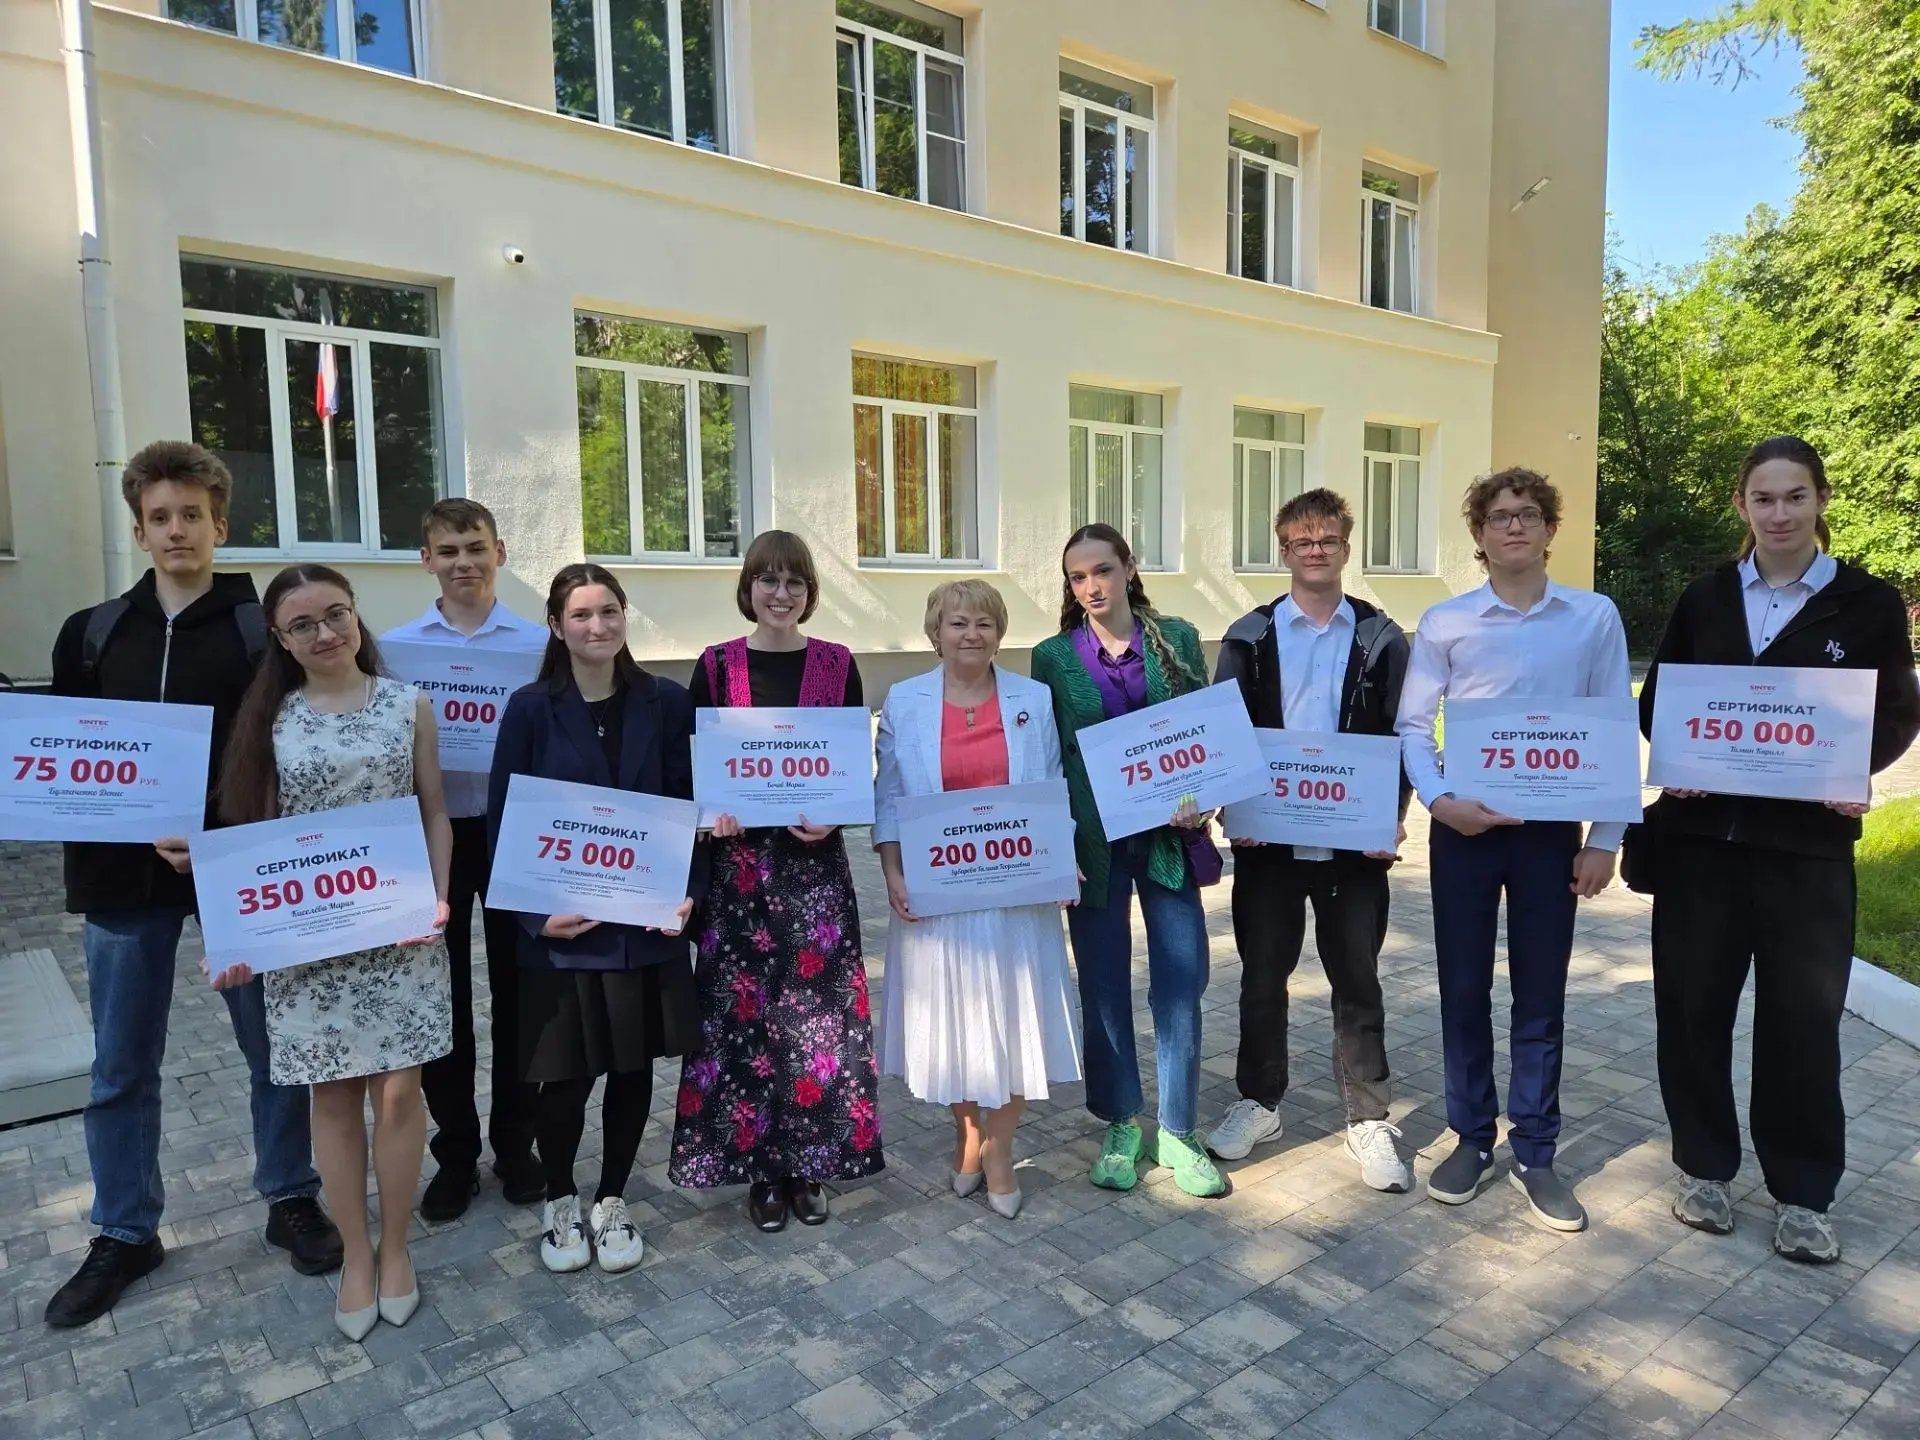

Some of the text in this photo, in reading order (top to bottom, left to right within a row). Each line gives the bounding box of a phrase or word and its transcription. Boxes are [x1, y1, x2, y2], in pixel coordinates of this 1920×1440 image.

[413, 680, 507, 696] СЕРТИФИКАТ
[444, 700, 496, 724] 000
[1708, 701, 1816, 715] СЕРТИФИКАТ
[1149, 719, 1170, 728] SINTEC
[1685, 717, 1743, 741] 150
[1754, 721, 1815, 746] 000
[30, 737, 152, 752] СЕРТИФИКАТ
[741, 740, 828, 750] СЕРТИФИКАТ
[1125, 724, 1206, 758] СЕРТИФИКАТ
[1492, 731, 1588, 740] СЕРТИФИКАТ
[724, 758, 773, 778] 150
[782, 757, 830, 777] 000
[1120, 760, 1152, 786] 75
[1159, 743, 1206, 774] 000
[1270, 762, 1355, 776] СЕРТИФИКАТ
[1481, 748, 1515, 769] 75
[1525, 748, 1579, 770] 000
[13, 756, 57, 782] 75
[70, 758, 137, 785] 000
[99, 788, 124, 797] Денис
[1270, 777, 1289, 798] 5
[1298, 779, 1346, 802] 000
[592, 805, 616, 814] SINTEC
[295, 833, 324, 843] SINTEC
[552, 819, 648, 841] СЕРТИФИКАТ
[943, 819, 1028, 836] СЕРТИФИКАТ
[256, 846, 371, 875] СЕРТИФИКАТ
[537, 835, 572, 862] 75
[582, 843, 635, 870] 000
[929, 842, 976, 867] 200
[985, 836, 1032, 860] 000
[236, 879, 303, 915] 350
[314, 866, 377, 899] 000
[328, 901, 355, 910] Мария
